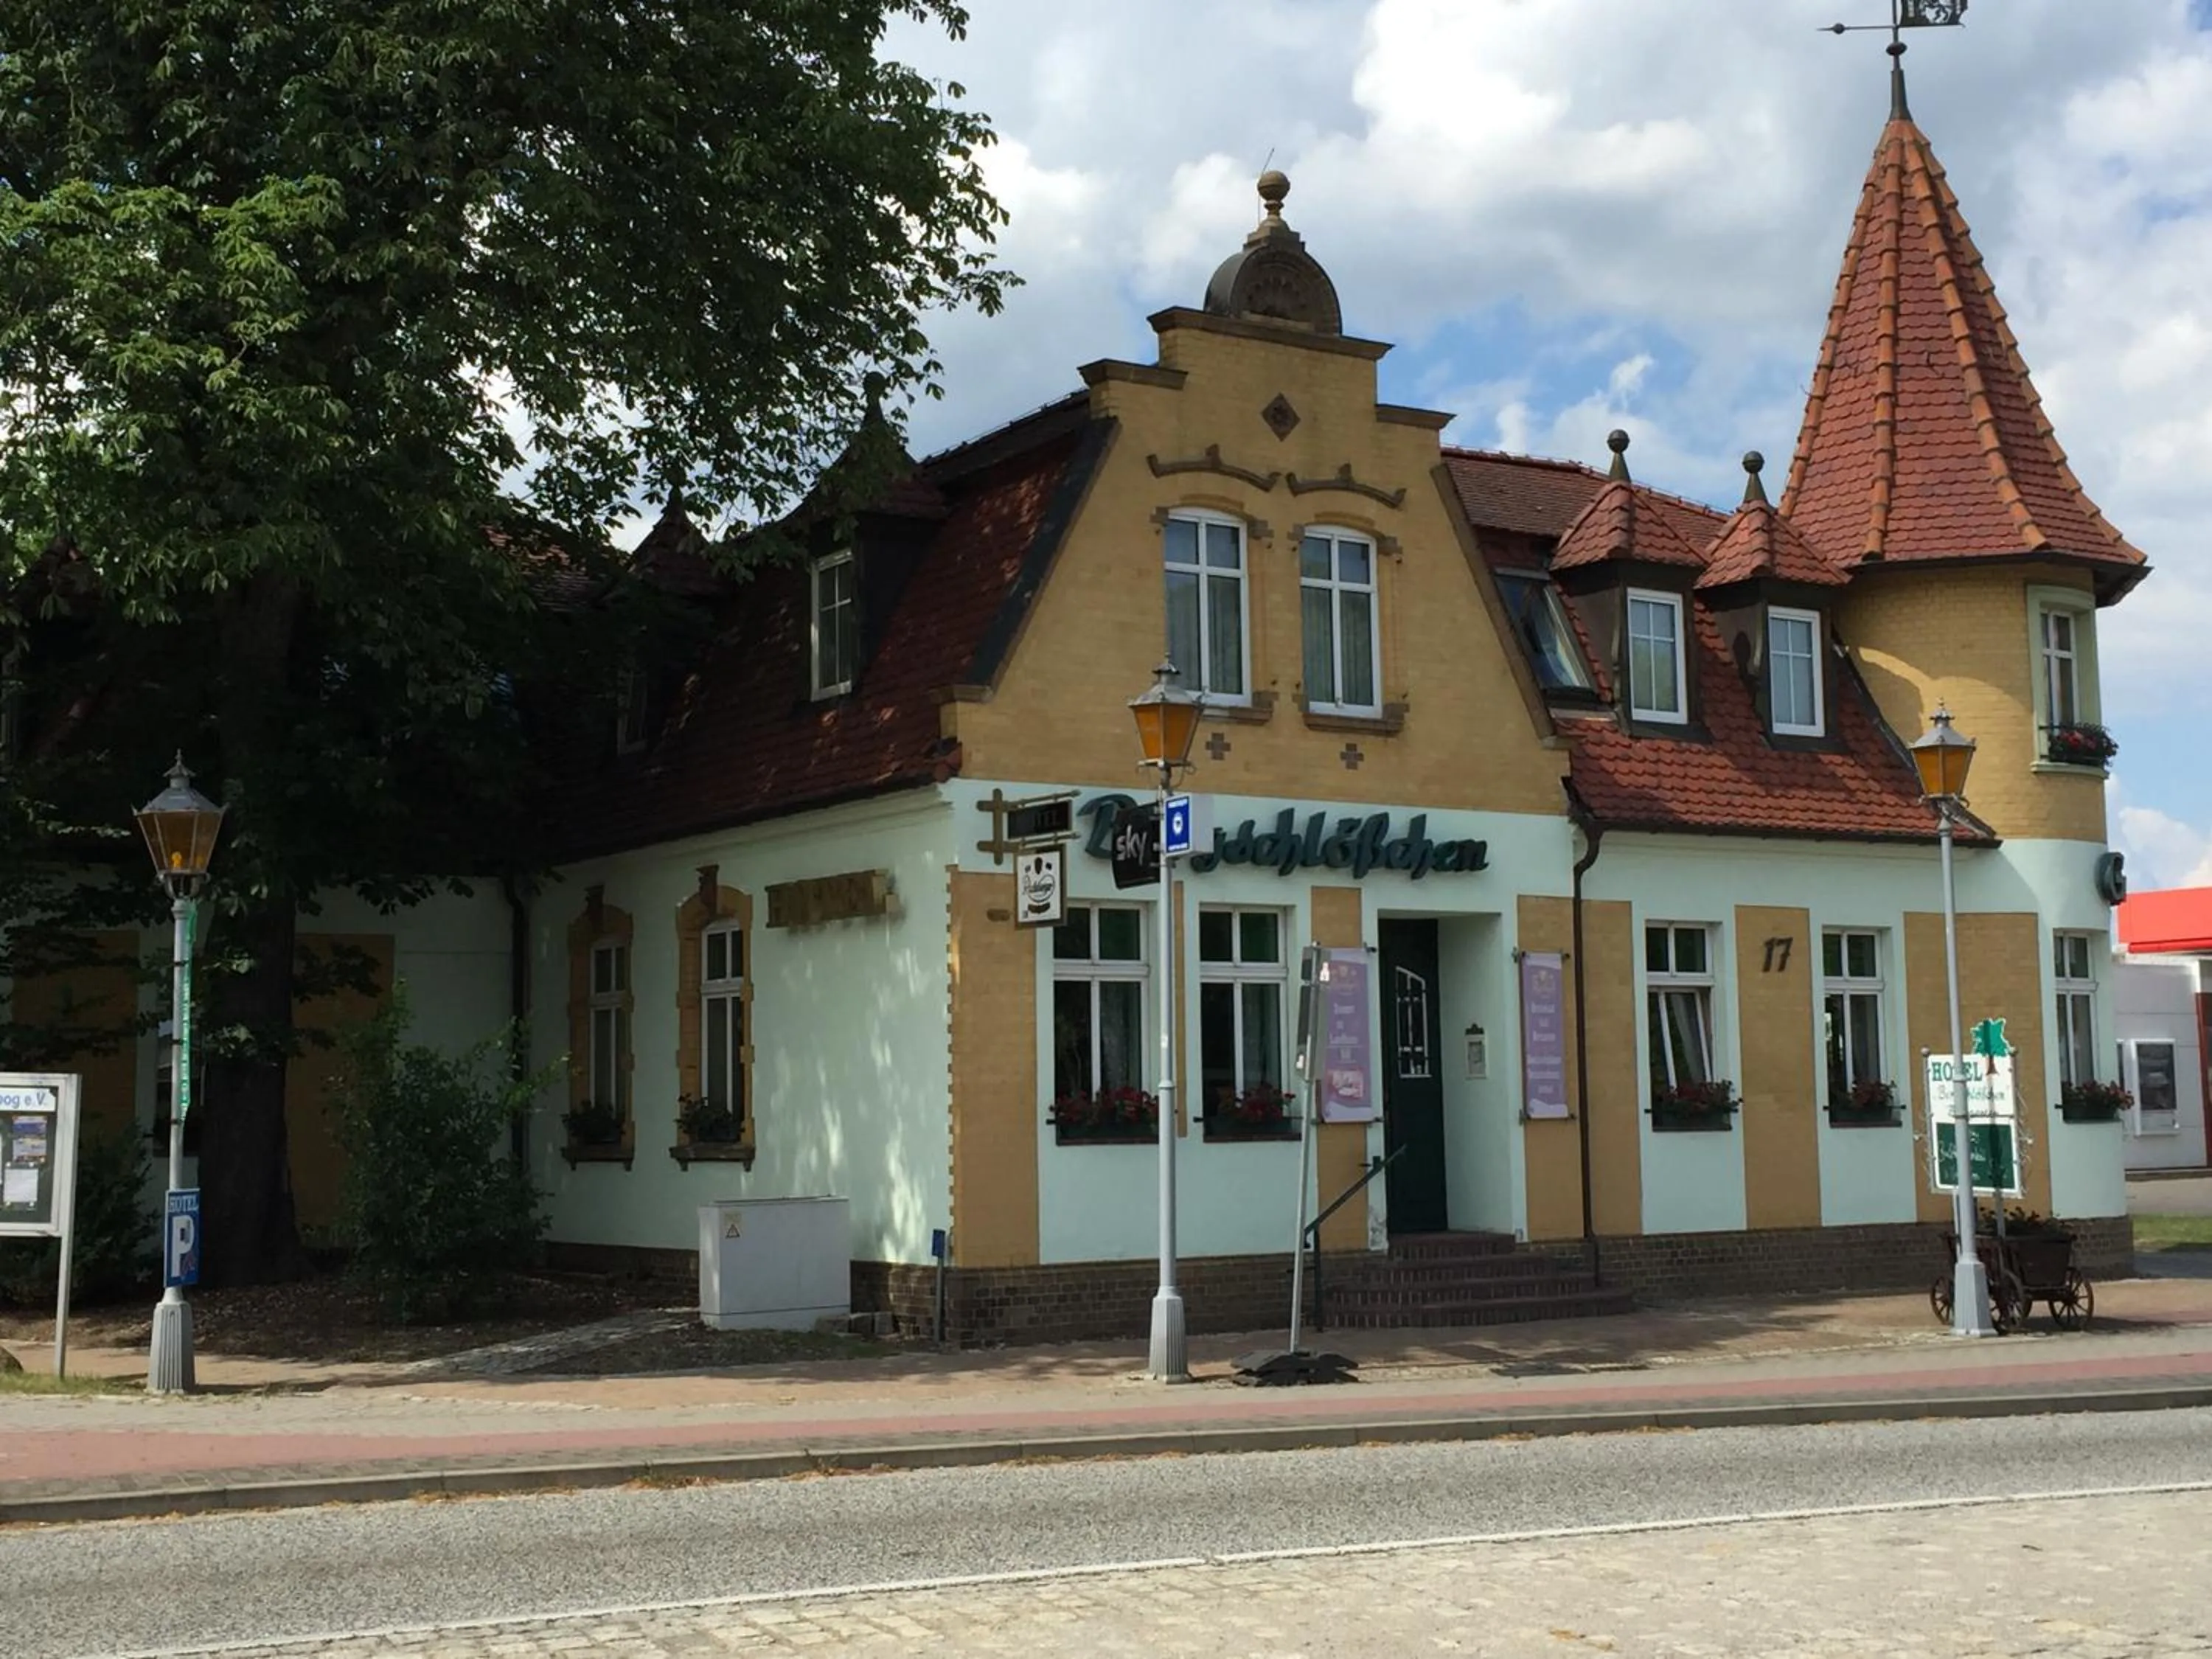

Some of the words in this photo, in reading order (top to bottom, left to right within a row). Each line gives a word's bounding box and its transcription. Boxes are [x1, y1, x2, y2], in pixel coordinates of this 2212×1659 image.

[1116, 824, 1147, 866] sky
[1761, 937, 1793, 973] 17
[1932, 1061, 1982, 1082] HOEL
[169, 1195, 198, 1213] HOTEL
[171, 1215, 195, 1278] P
